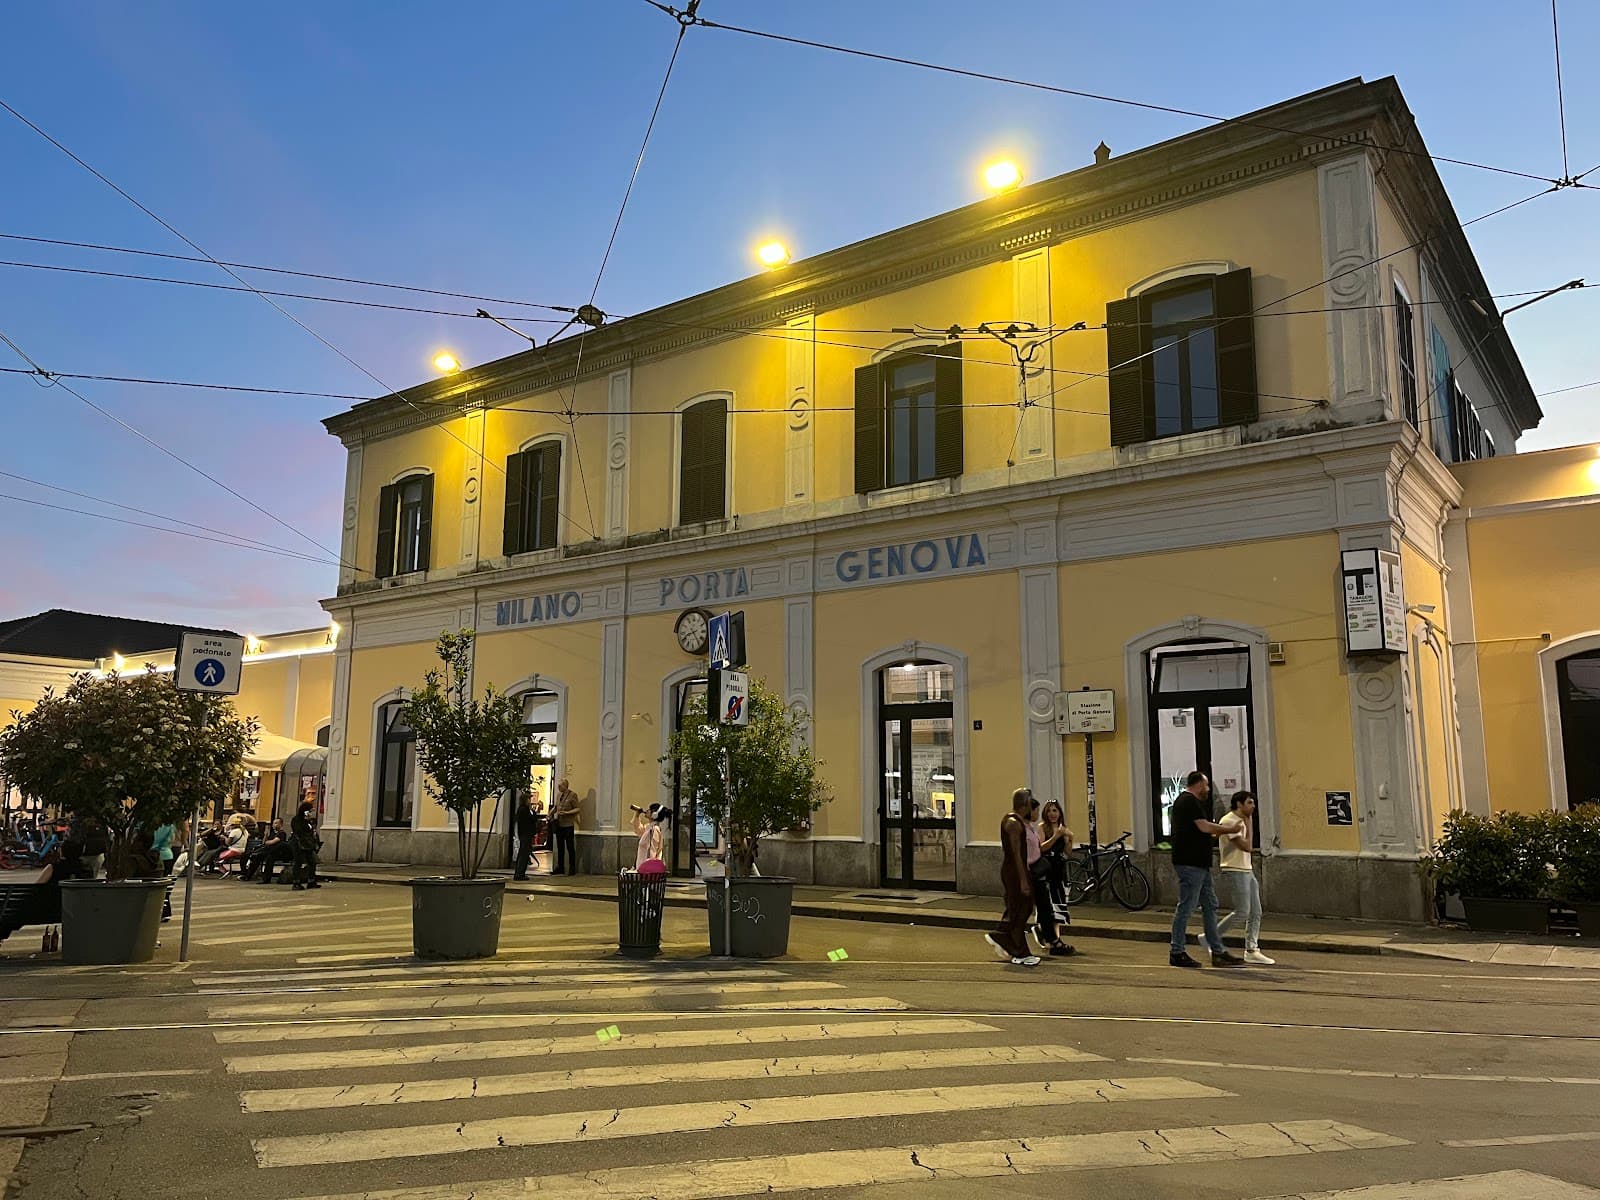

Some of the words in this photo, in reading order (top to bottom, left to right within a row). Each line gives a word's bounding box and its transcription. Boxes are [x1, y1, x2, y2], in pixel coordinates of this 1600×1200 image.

[496, 591, 581, 626] MILANO
[660, 567, 749, 606] PORTA
[836, 533, 986, 582] GENOVA
[1344, 568, 1374, 595] T
[1380, 552, 1399, 593] T
[192, 647, 232, 657] pedonale
[204, 639, 222, 647] area
